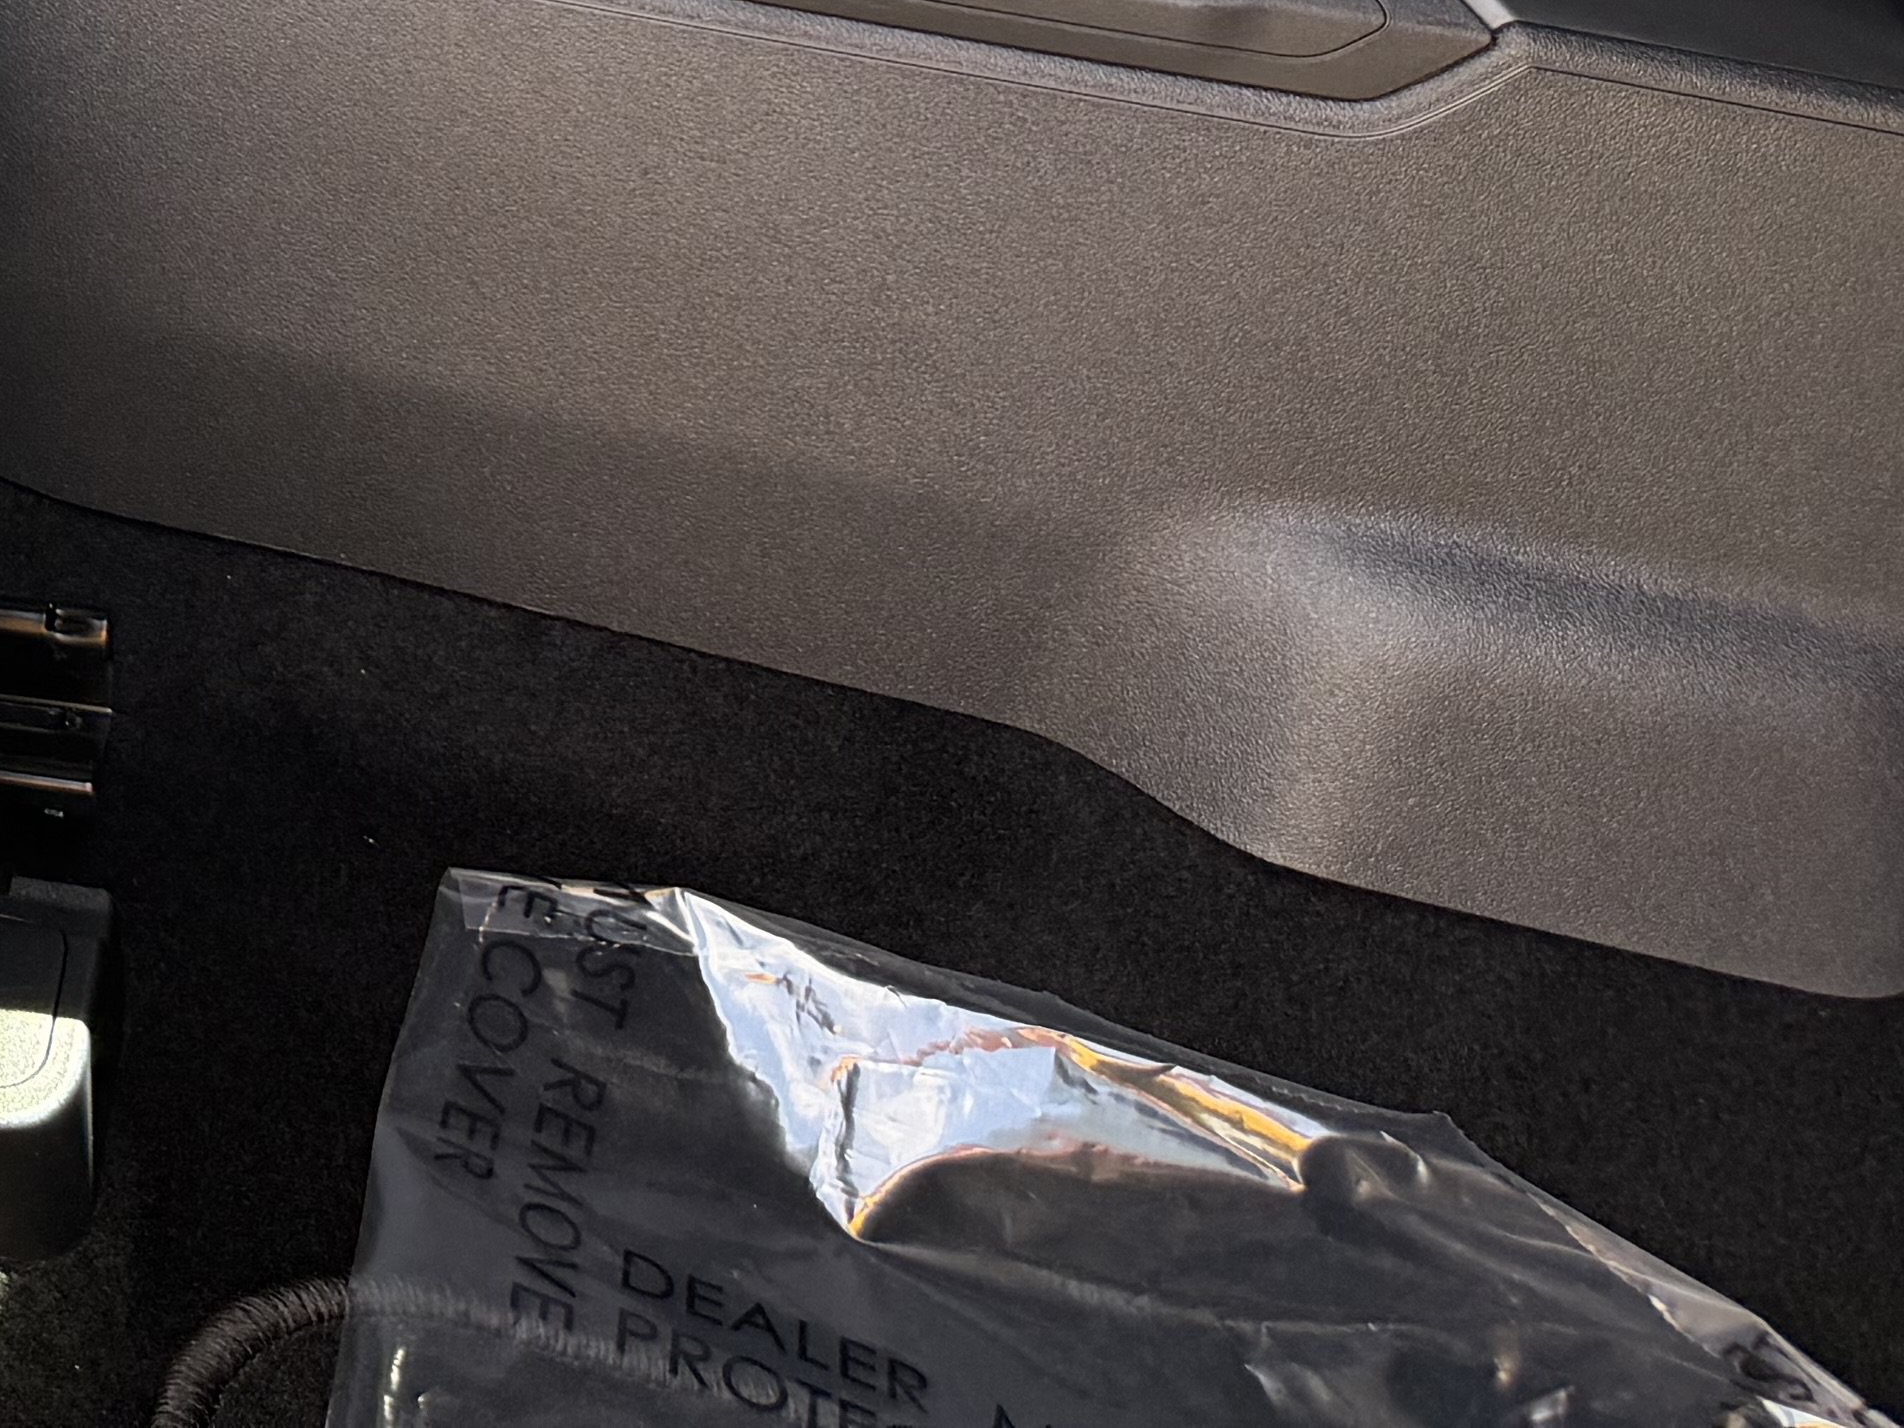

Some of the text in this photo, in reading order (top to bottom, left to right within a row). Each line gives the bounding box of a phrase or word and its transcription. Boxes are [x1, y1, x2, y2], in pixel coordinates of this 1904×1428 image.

[433, 940, 542, 1181] COVER
[509, 884, 652, 1333] UST REMOVE
[621, 1248, 929, 1415] DEALER
